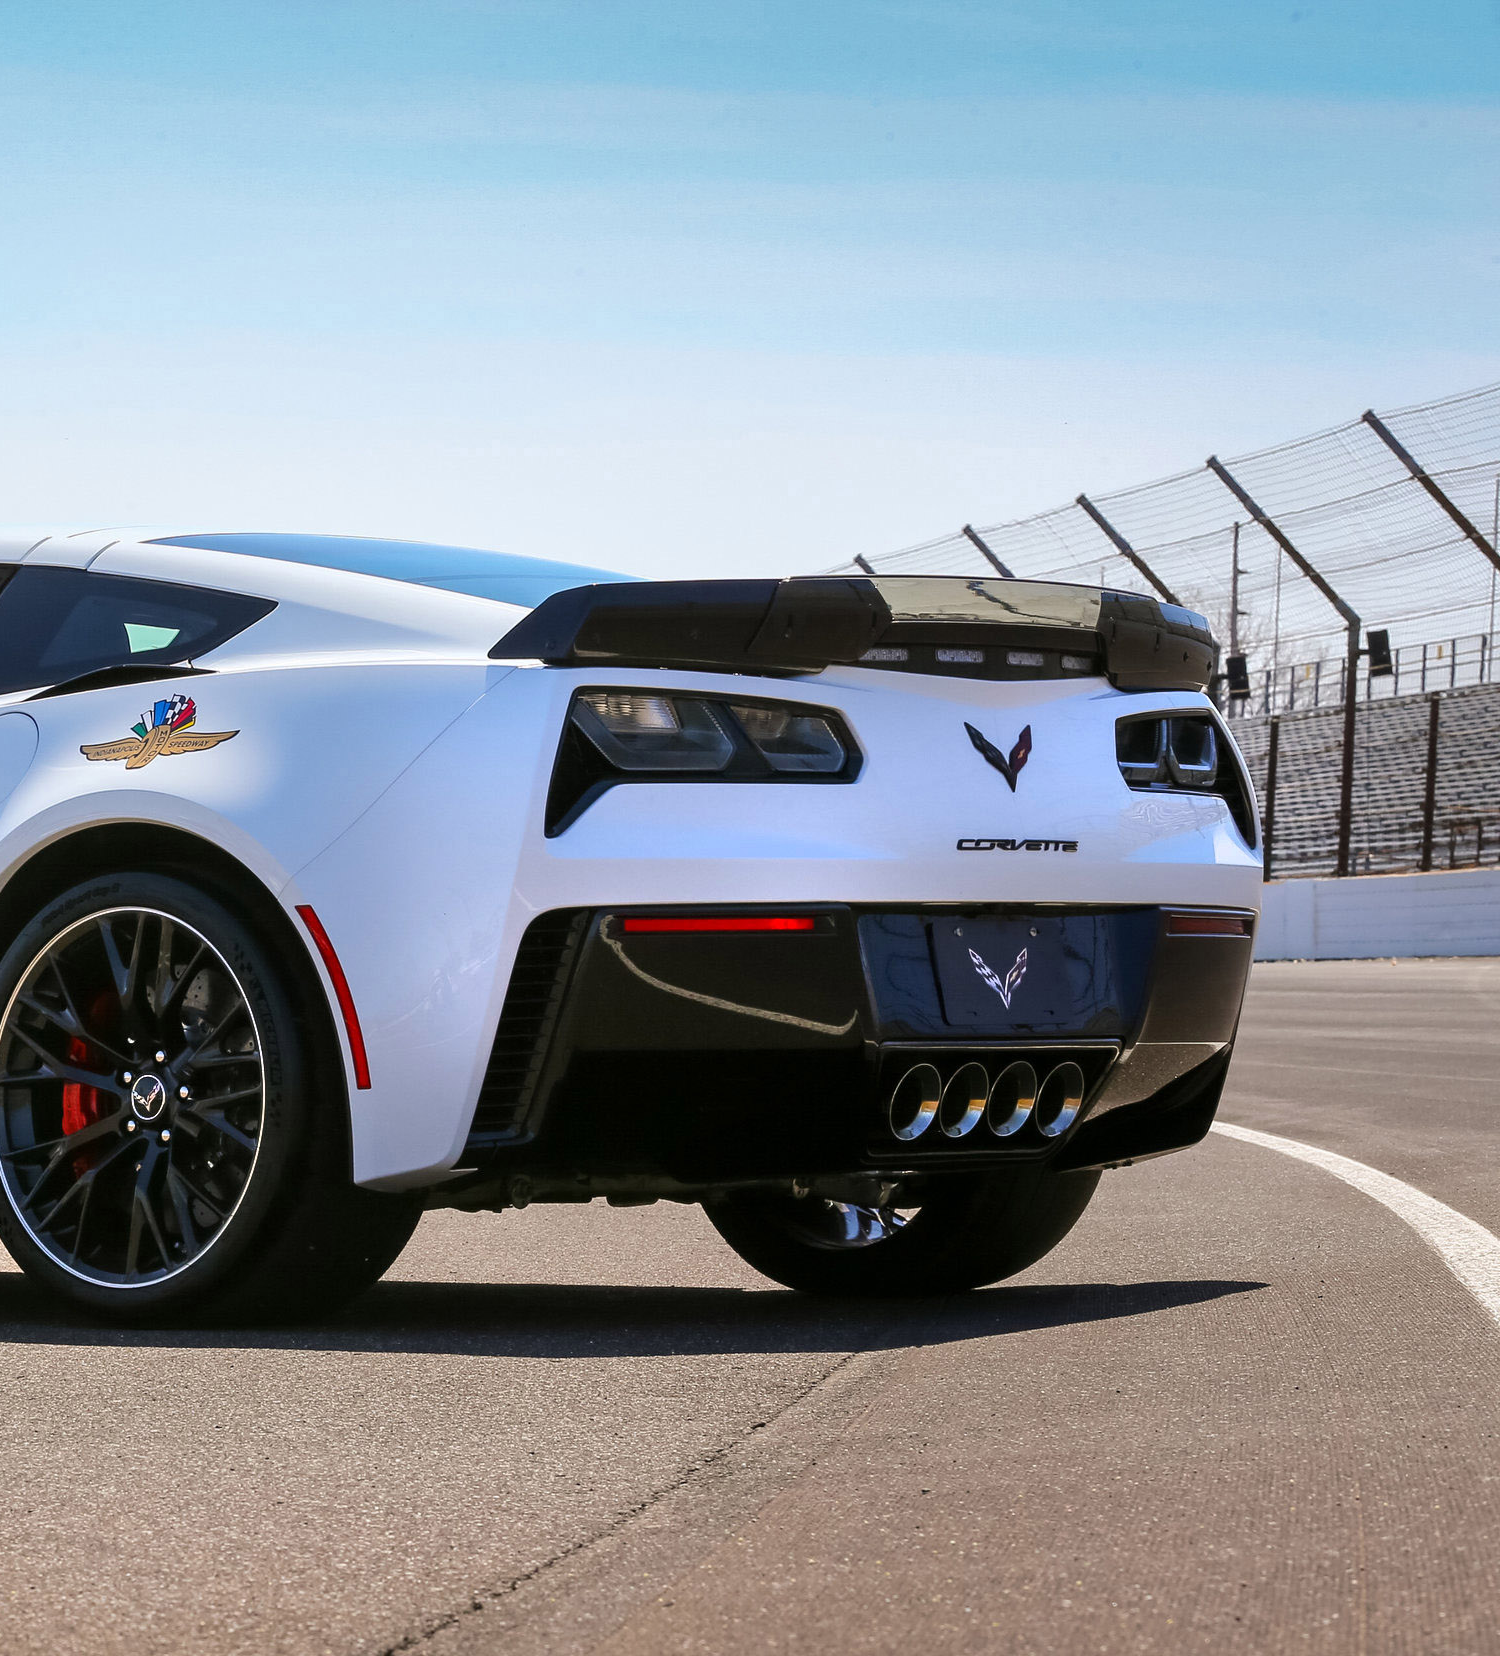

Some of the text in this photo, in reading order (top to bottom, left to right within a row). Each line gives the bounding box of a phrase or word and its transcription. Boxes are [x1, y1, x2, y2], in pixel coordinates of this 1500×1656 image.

[93, 745, 140, 758] INDIANAPOLIS
[141, 730, 168, 763] MOTOR
[168, 740, 209, 749] SPEEDWAY
[956, 838, 1079, 853] CORVETTE
